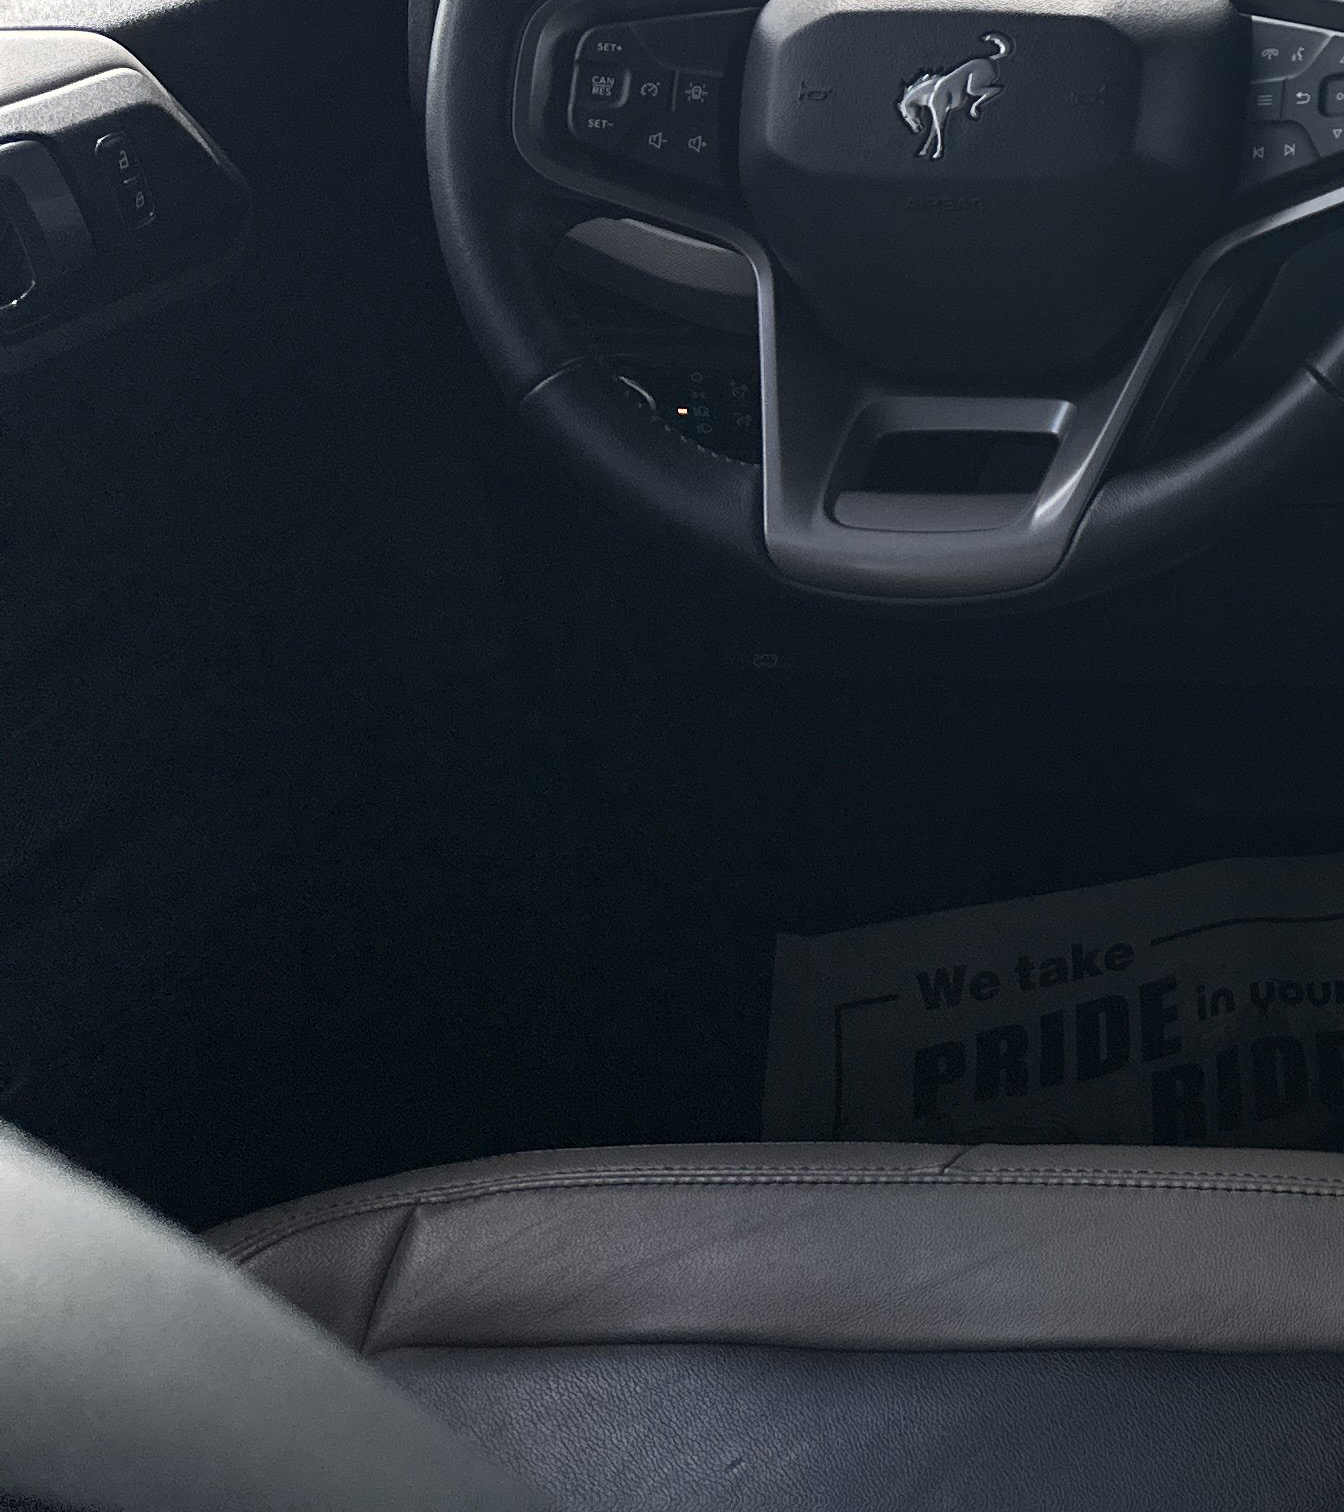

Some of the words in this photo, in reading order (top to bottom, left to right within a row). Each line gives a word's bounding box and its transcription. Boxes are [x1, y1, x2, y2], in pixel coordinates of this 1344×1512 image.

[592, 75, 614, 86] CAN
[592, 87, 612, 96] RES
[916, 966, 999, 1010] We
[1014, 938, 1135, 993] take
[912, 975, 1184, 1123] PRIDE
[1195, 983, 1236, 1020] in
